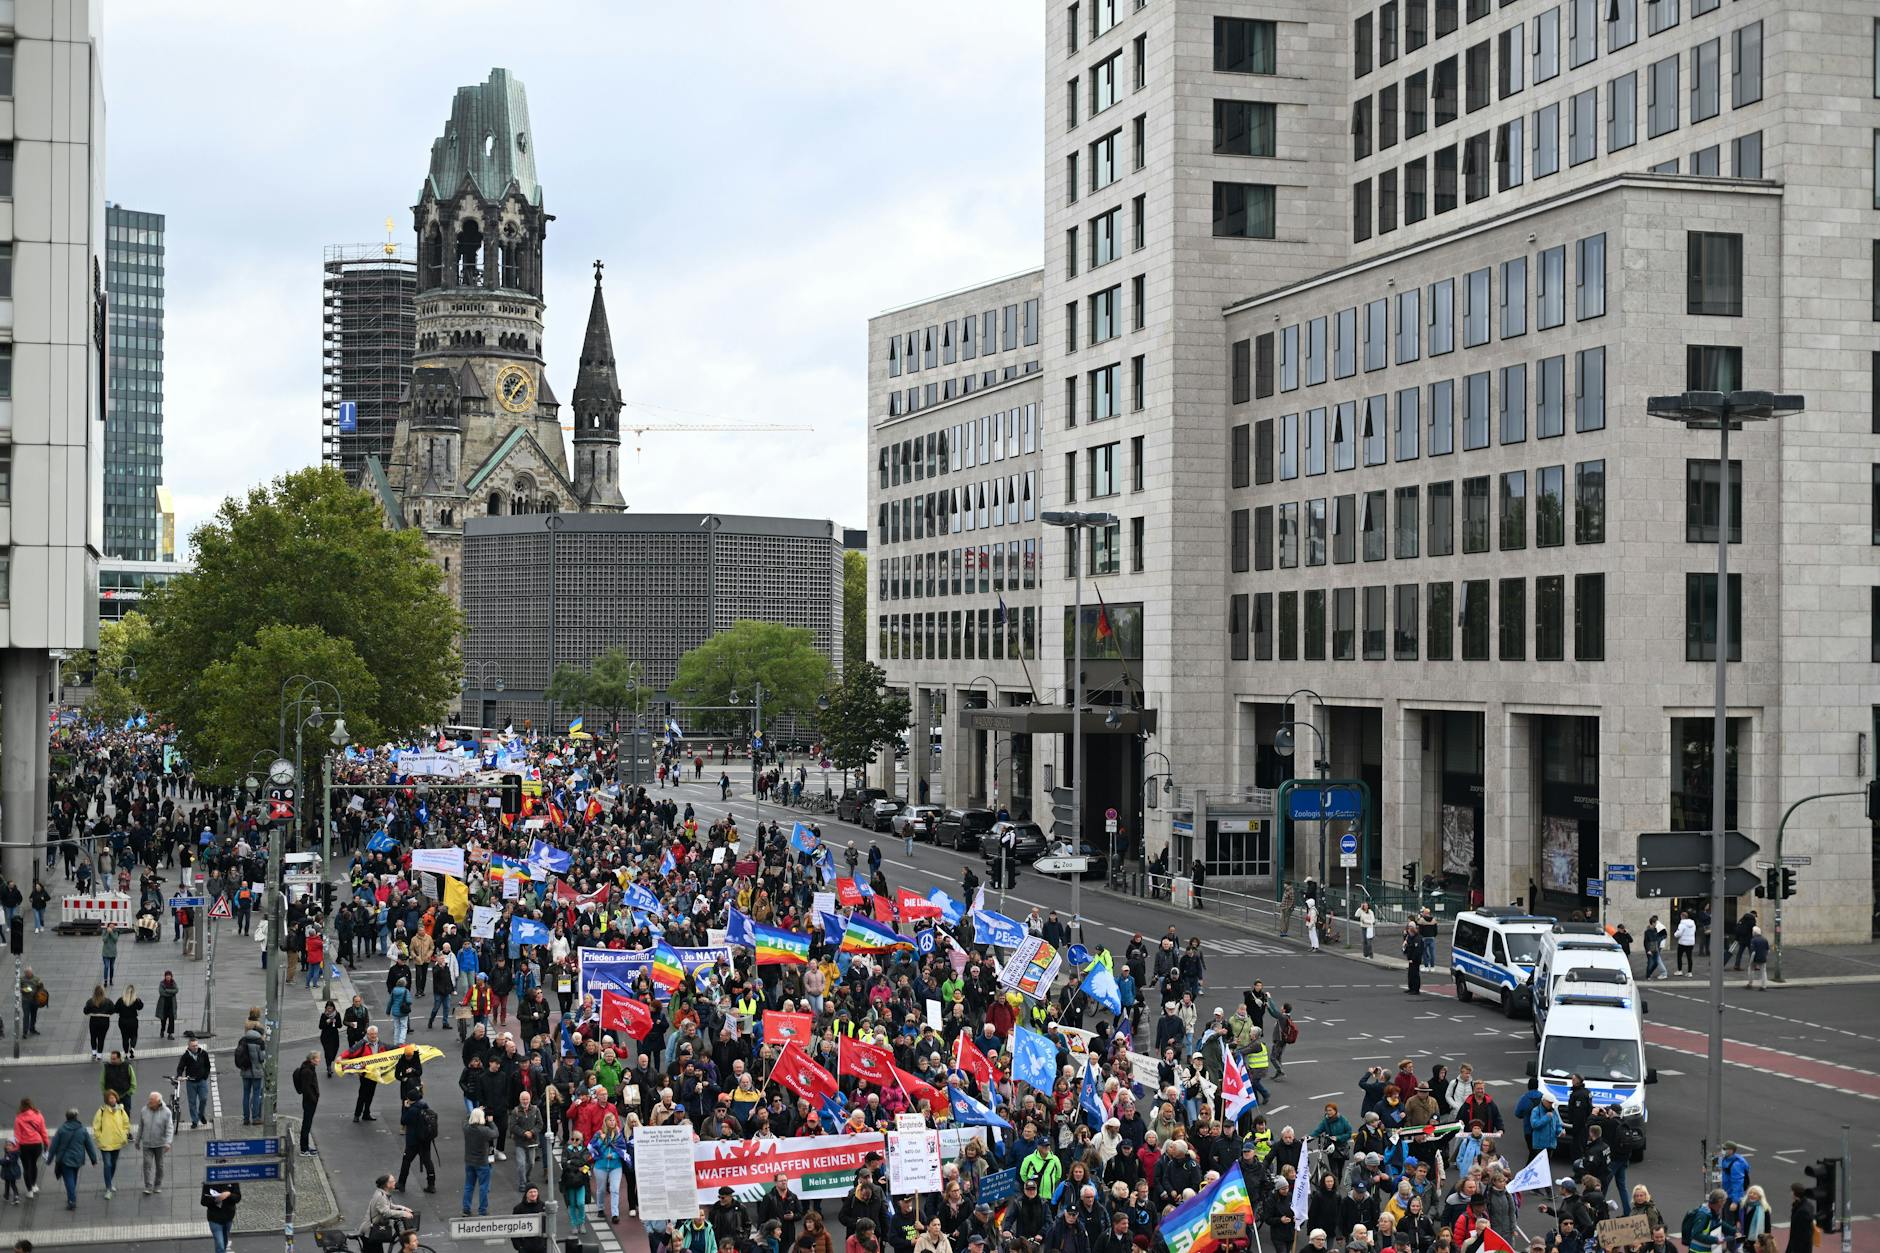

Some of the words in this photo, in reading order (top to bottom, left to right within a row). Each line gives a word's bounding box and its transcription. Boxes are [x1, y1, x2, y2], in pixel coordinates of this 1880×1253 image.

[341, 402, 355, 422] T
[1574, 796, 1599, 805] ZOOFENSTE
[1294, 809, 1334, 819] Zoologisher
[904, 898, 916, 908] DIE
[767, 937, 802, 954] PACE
[583, 952, 614, 961] Frieden
[850, 1062, 882, 1079] Deutschlands
[1567, 1089, 1613, 1099] PIZEI
[698, 1165, 747, 1180] WAFFEN
[750, 1158, 810, 1176] SCHAFFEN
[813, 1153, 855, 1168] KEINEN
[809, 1176, 827, 1186] Nein
[829, 1176, 838, 1184] zu
[840, 1175, 858, 1183] neu
[458, 1221, 533, 1234] Hardenbergplatz
[1600, 1220, 1647, 1233] Milliarden
